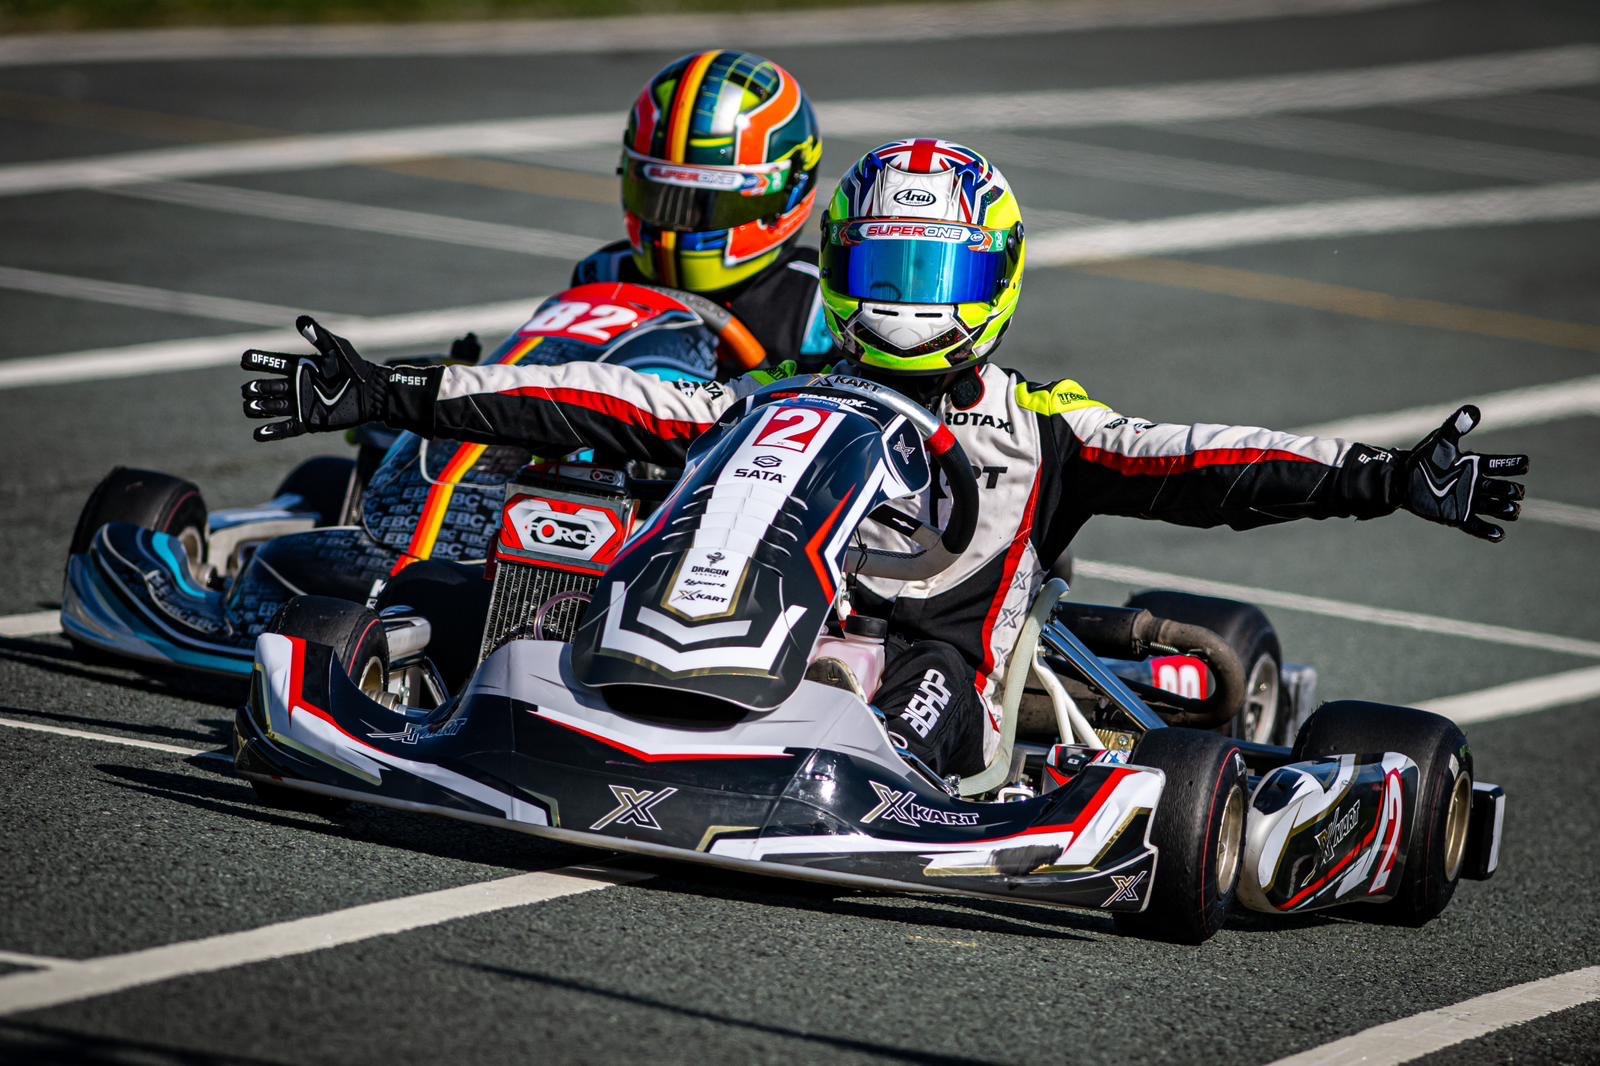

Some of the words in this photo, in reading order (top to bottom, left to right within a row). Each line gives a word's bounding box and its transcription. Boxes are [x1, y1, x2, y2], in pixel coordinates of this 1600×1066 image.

[901, 189, 932, 203] Arai
[866, 226, 963, 241] SUPERONE
[251, 353, 288, 370] OFFSET
[388, 373, 428, 387] OFFSET
[756, 408, 822, 452] 2
[1488, 456, 1523, 469] OFFSET
[734, 468, 784, 484] SATA
[380, 514, 420, 529] EBC
[691, 565, 730, 577] DRAGON
[695, 593, 728, 603] KART
[900, 668, 952, 739] BISHOP
[911, 802, 980, 827] KART
